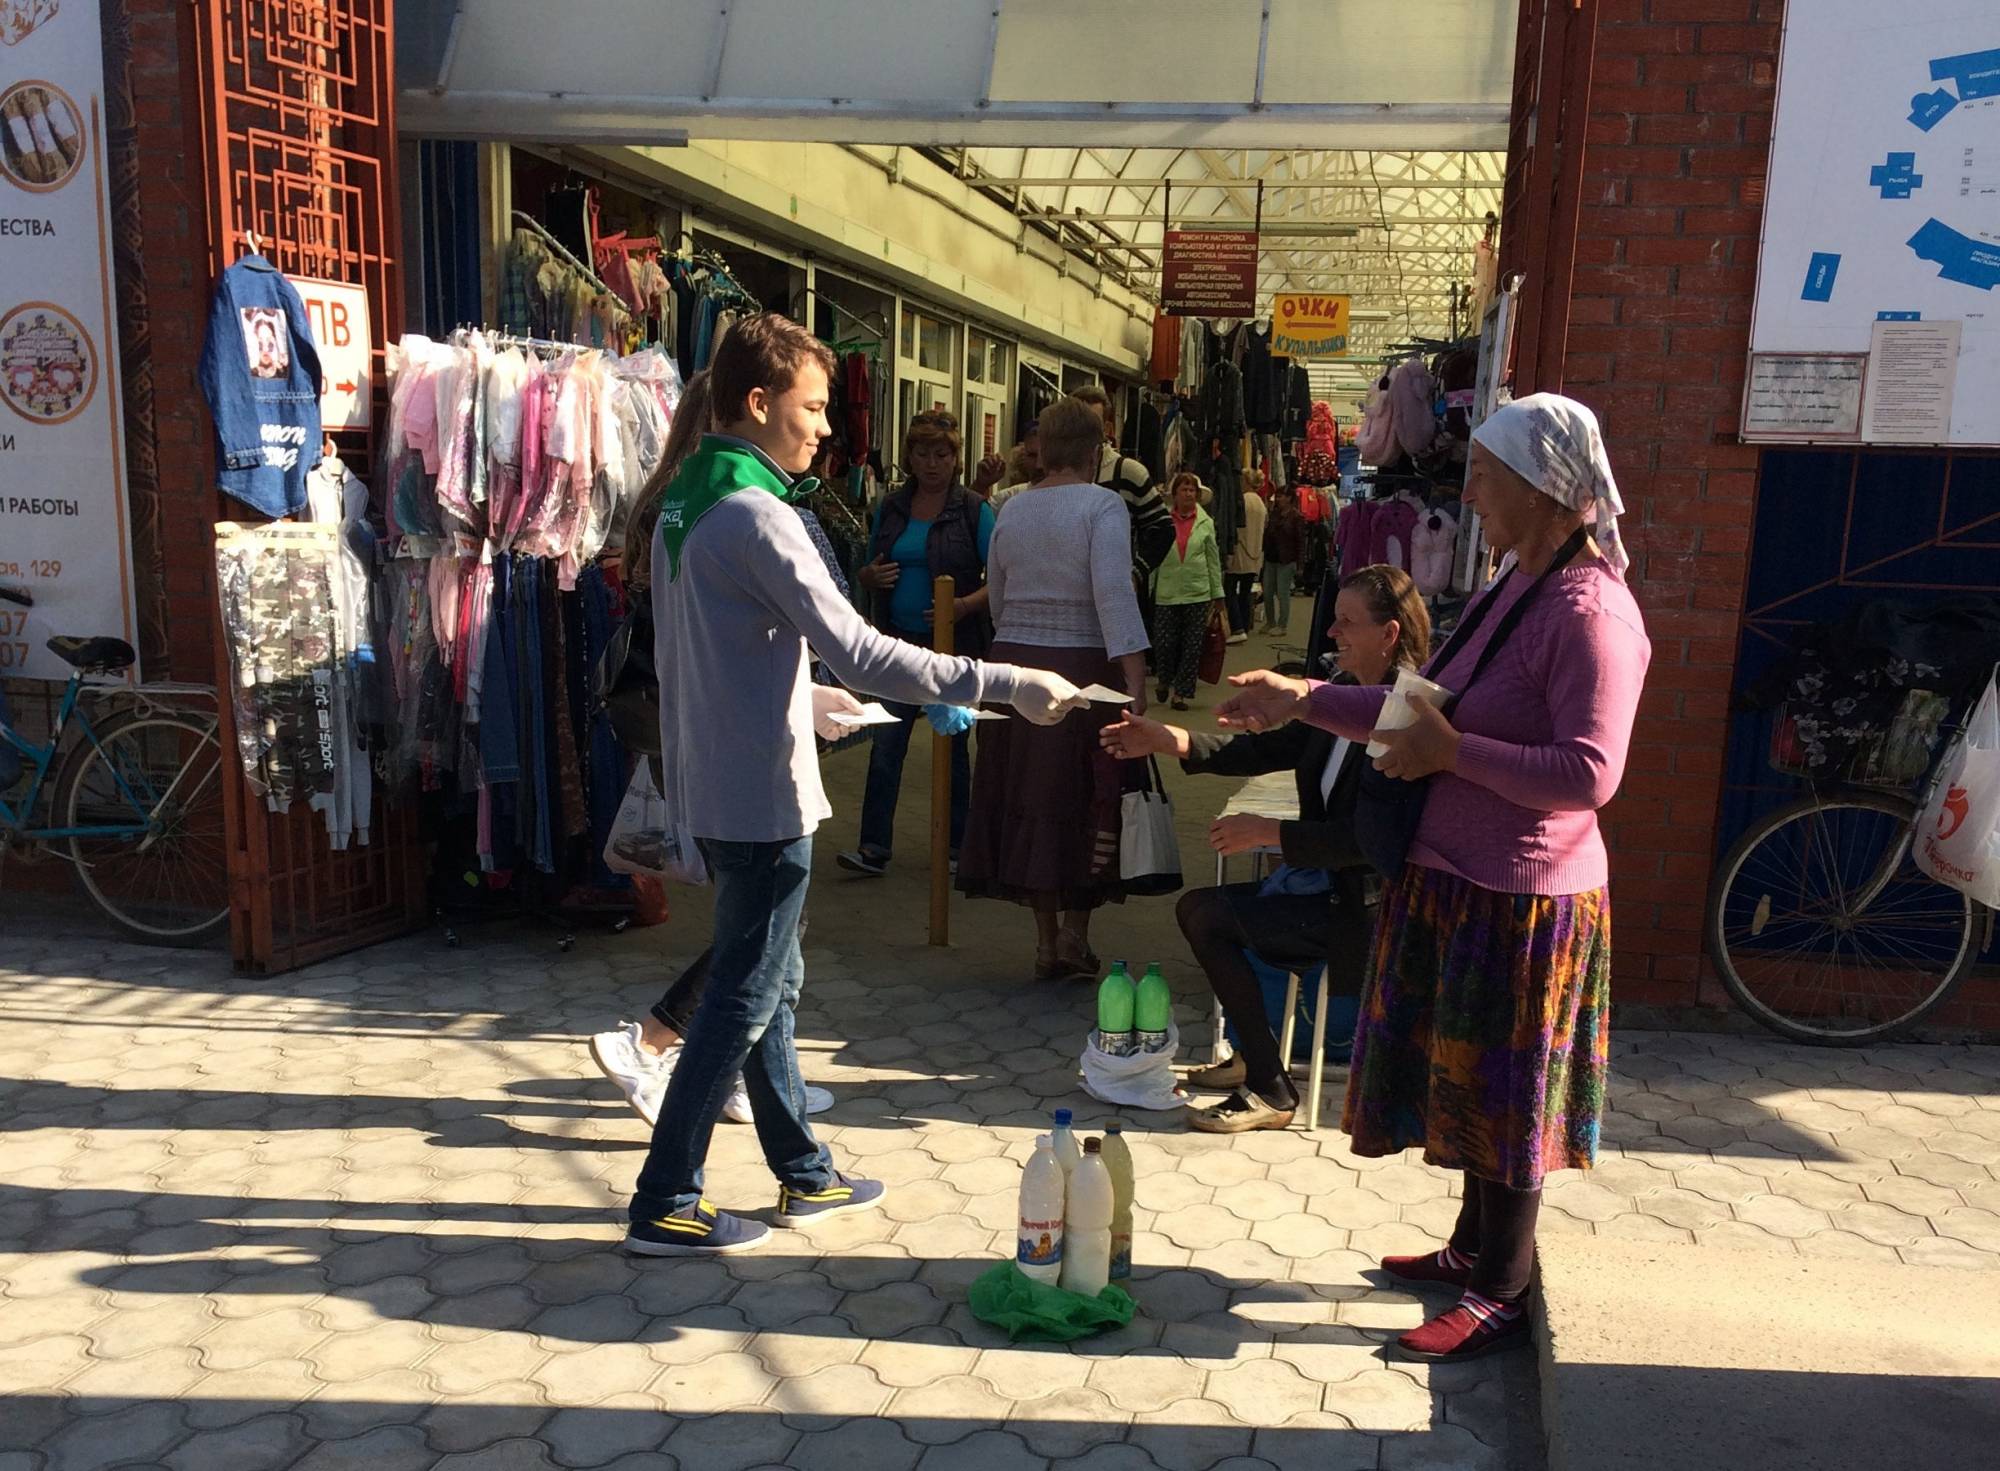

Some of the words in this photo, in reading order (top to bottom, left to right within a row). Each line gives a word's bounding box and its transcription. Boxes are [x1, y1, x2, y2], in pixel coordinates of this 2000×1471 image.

[1179, 234, 1203, 242] РЕМОНТ
[1210, 234, 1246, 242] НАСТРОЙКА
[1282, 297, 1340, 319] ОЧКИ
[1275, 334, 1346, 355] КУПАЛЬНИКИ
[9, 498, 79, 516] РАБОТЫ
[30, 560, 62, 577] 129
